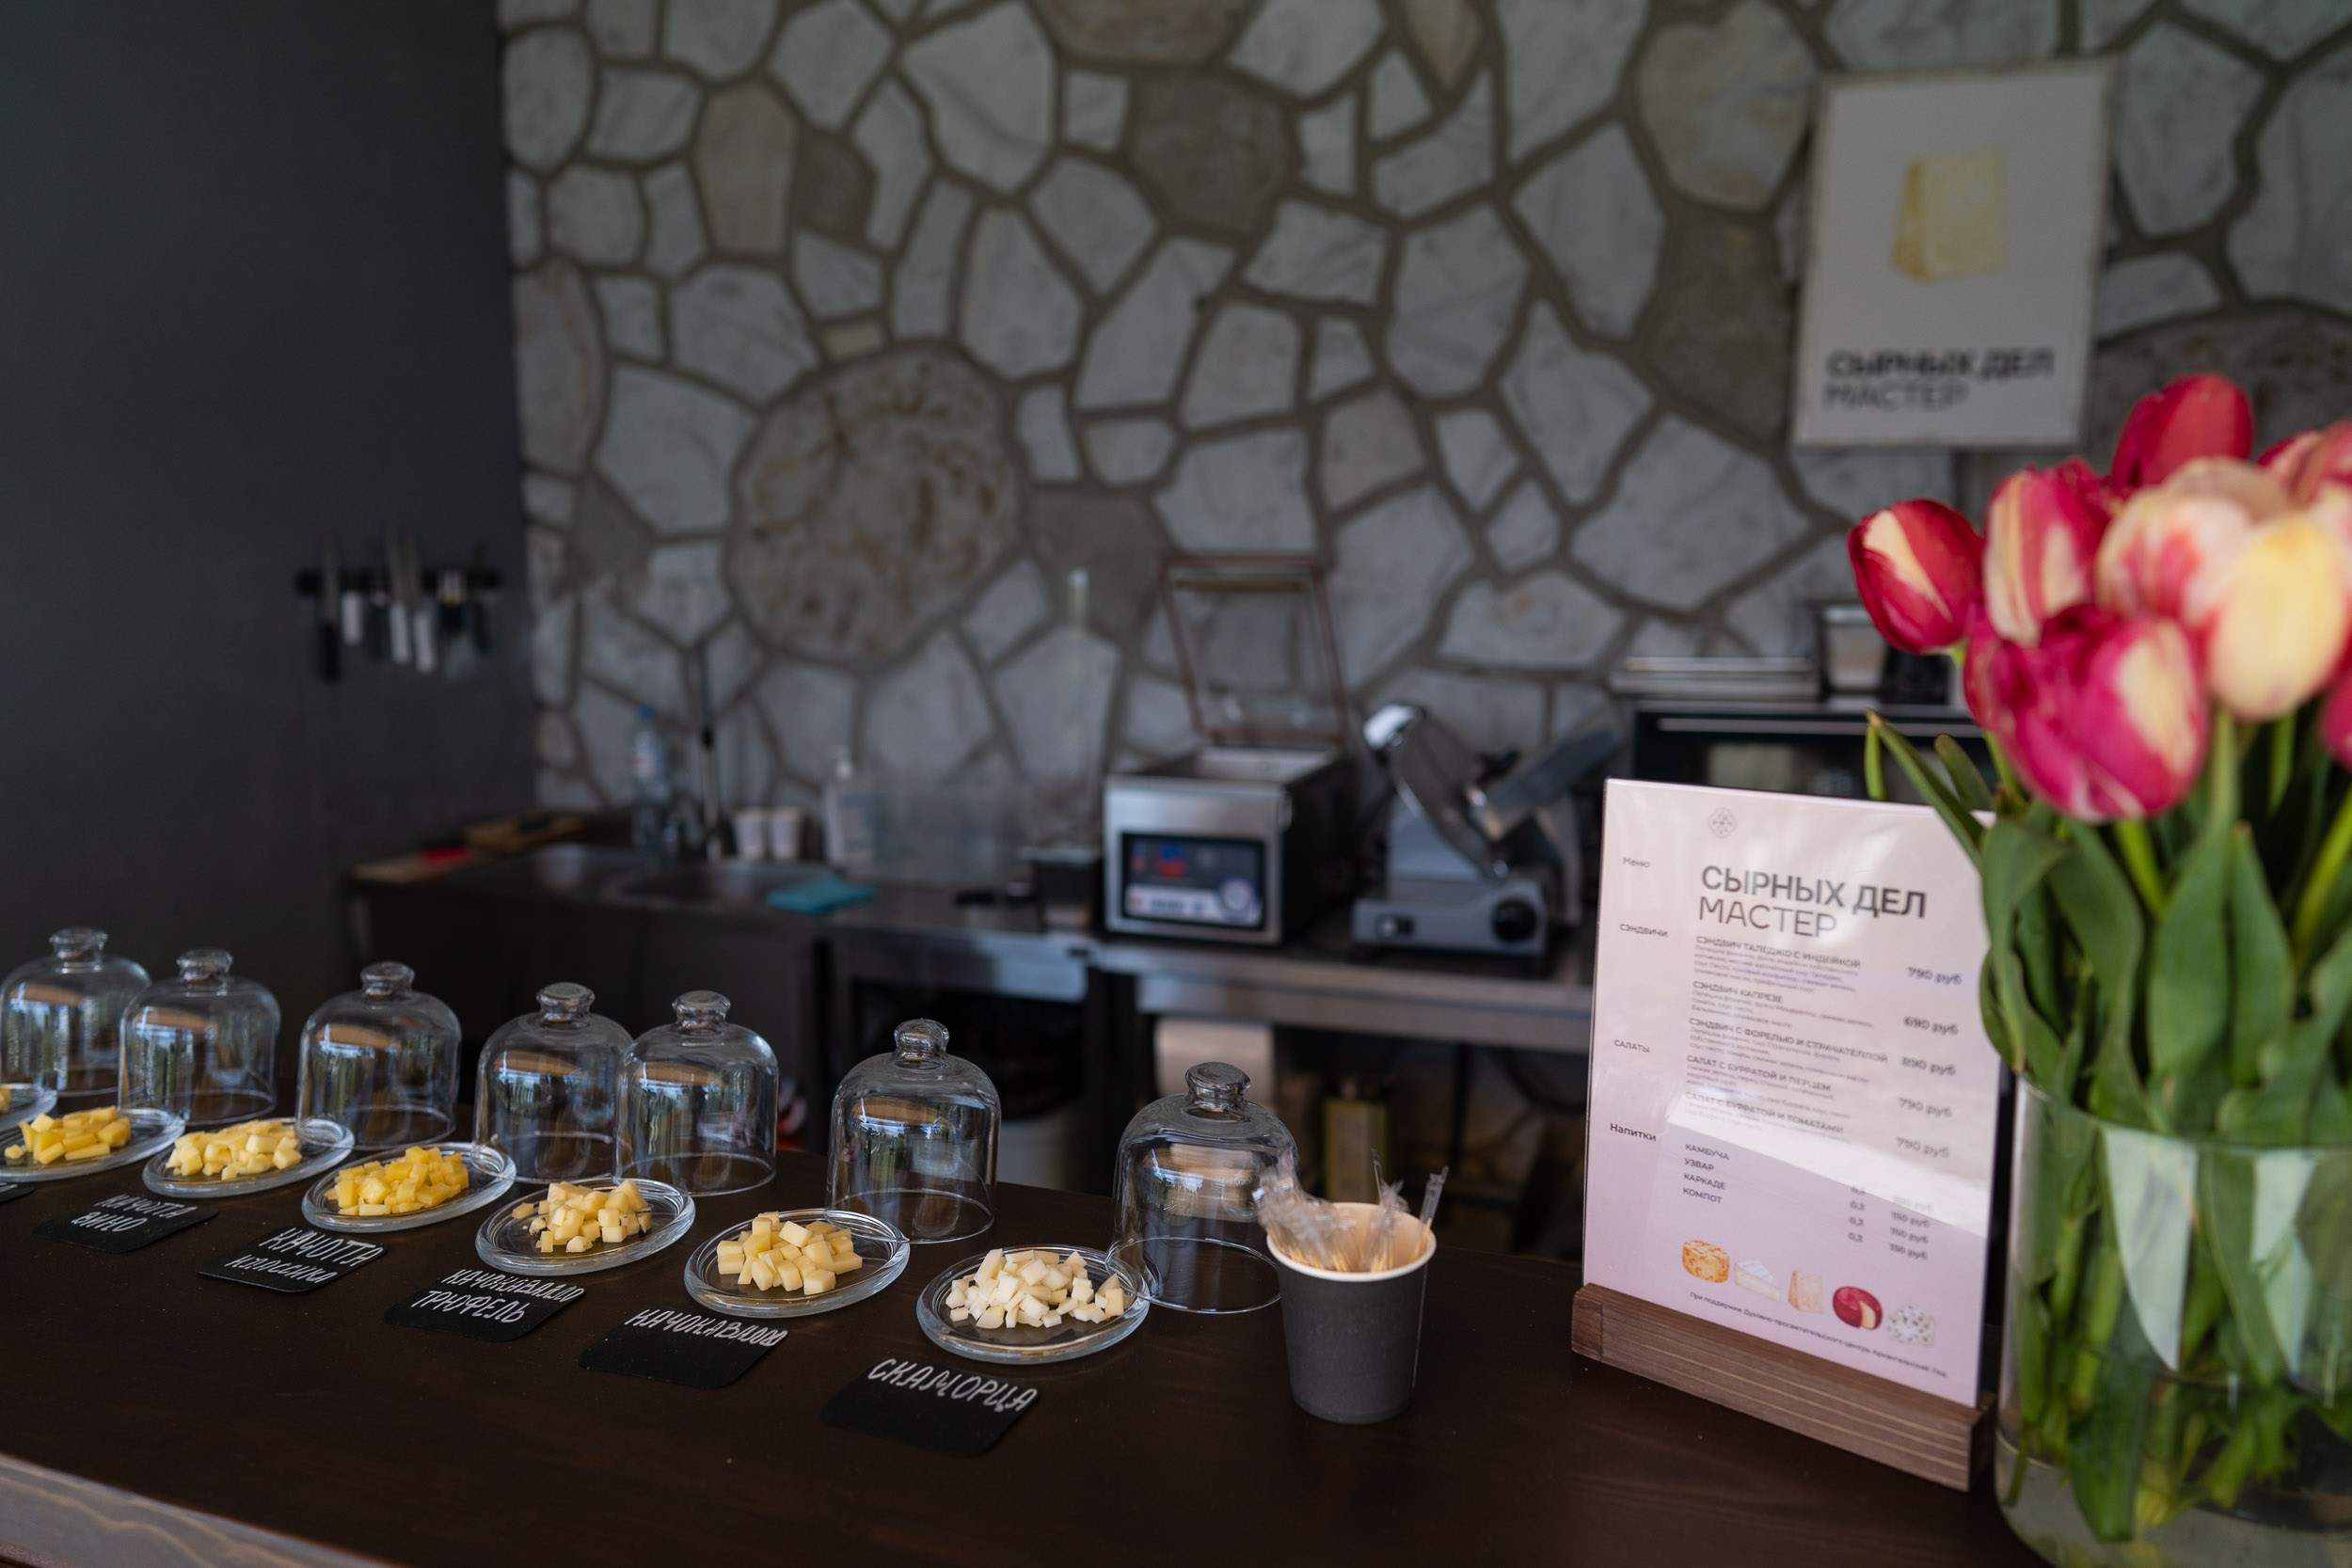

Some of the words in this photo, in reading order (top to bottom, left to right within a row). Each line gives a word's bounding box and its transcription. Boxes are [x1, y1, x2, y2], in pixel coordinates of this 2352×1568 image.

[1821, 381, 1969, 412] МАСТЕР
[1623, 857, 1650, 868] Меню
[1701, 864, 1846, 908] СЫРНЫХ
[1852, 885, 1926, 918] ДЕЛ
[1698, 896, 1836, 938] МАСТЕР
[1619, 924, 1668, 938] СЭНДВИЧИ
[1696, 936, 1741, 949] СЭНДВИЧ
[1934, 973, 1963, 986] руб
[1692, 981, 1739, 995] СЭНДВИЧ
[1689, 1017, 1733, 1032] СЭНДВИЧ
[1736, 1026, 1741, 1035] С
[1744, 1029, 1794, 1044] ФОРЕЛЬЮ
[1931, 1022, 1959, 1036] руб
[1613, 1039, 1650, 1053] САЛАТЫ
[1686, 1054, 1717, 1068] САЛАТ
[1727, 1063, 1777, 1080] БУРРАТОЙ
[1930, 1064, 1956, 1077] руб
[1926, 1104, 1952, 1117] руб
[1610, 1122, 1657, 1142] Напитки
[1685, 1144, 1730, 1160] КАМБУЧА
[1923, 1144, 1949, 1158] руб
[1684, 1158, 1714, 1171] УЗВАР
[1684, 1173, 1725, 1190] КАРКАДЕ
[1683, 1187, 1723, 1203] КОМПОТ
[94, 1193, 198, 1219] КАЧОТТА
[71, 1212, 148, 1232] ВИНО
[259, 1227, 384, 1267] КАЧОТТА
[224, 1254, 338, 1284] КЛАССИКА
[1690, 1291, 1703, 1302] При
[410, 1291, 530, 1323] ТРЮФЕЛЬ
[867, 1357, 1038, 1413] СКАМОРЦА
